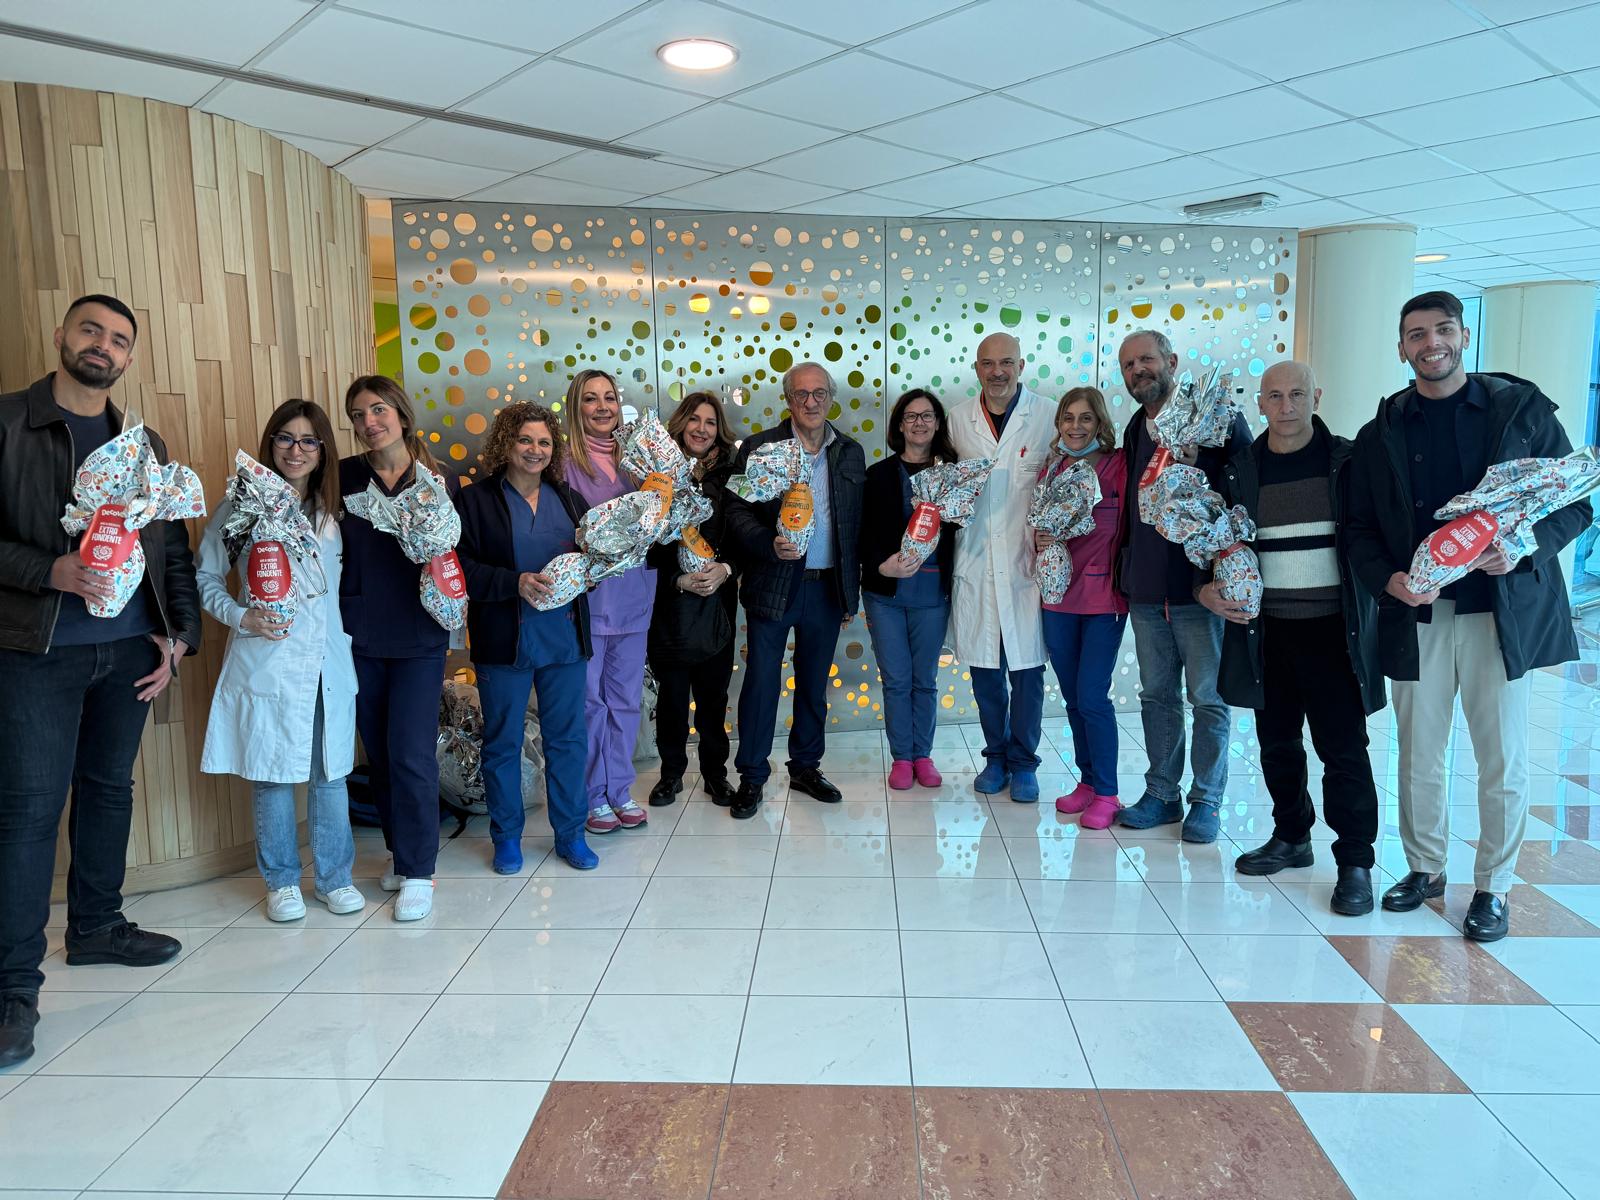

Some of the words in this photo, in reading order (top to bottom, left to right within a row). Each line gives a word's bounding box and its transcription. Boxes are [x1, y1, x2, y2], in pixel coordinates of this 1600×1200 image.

[99, 526, 118, 535] EXTRA
[1459, 525, 1477, 542] EXTRA
[92, 532, 122, 545] FONDENTE
[1449, 528, 1474, 550] FONDENTE
[260, 563, 278, 571] EXTRA
[256, 569, 283, 578] FONDENTE
